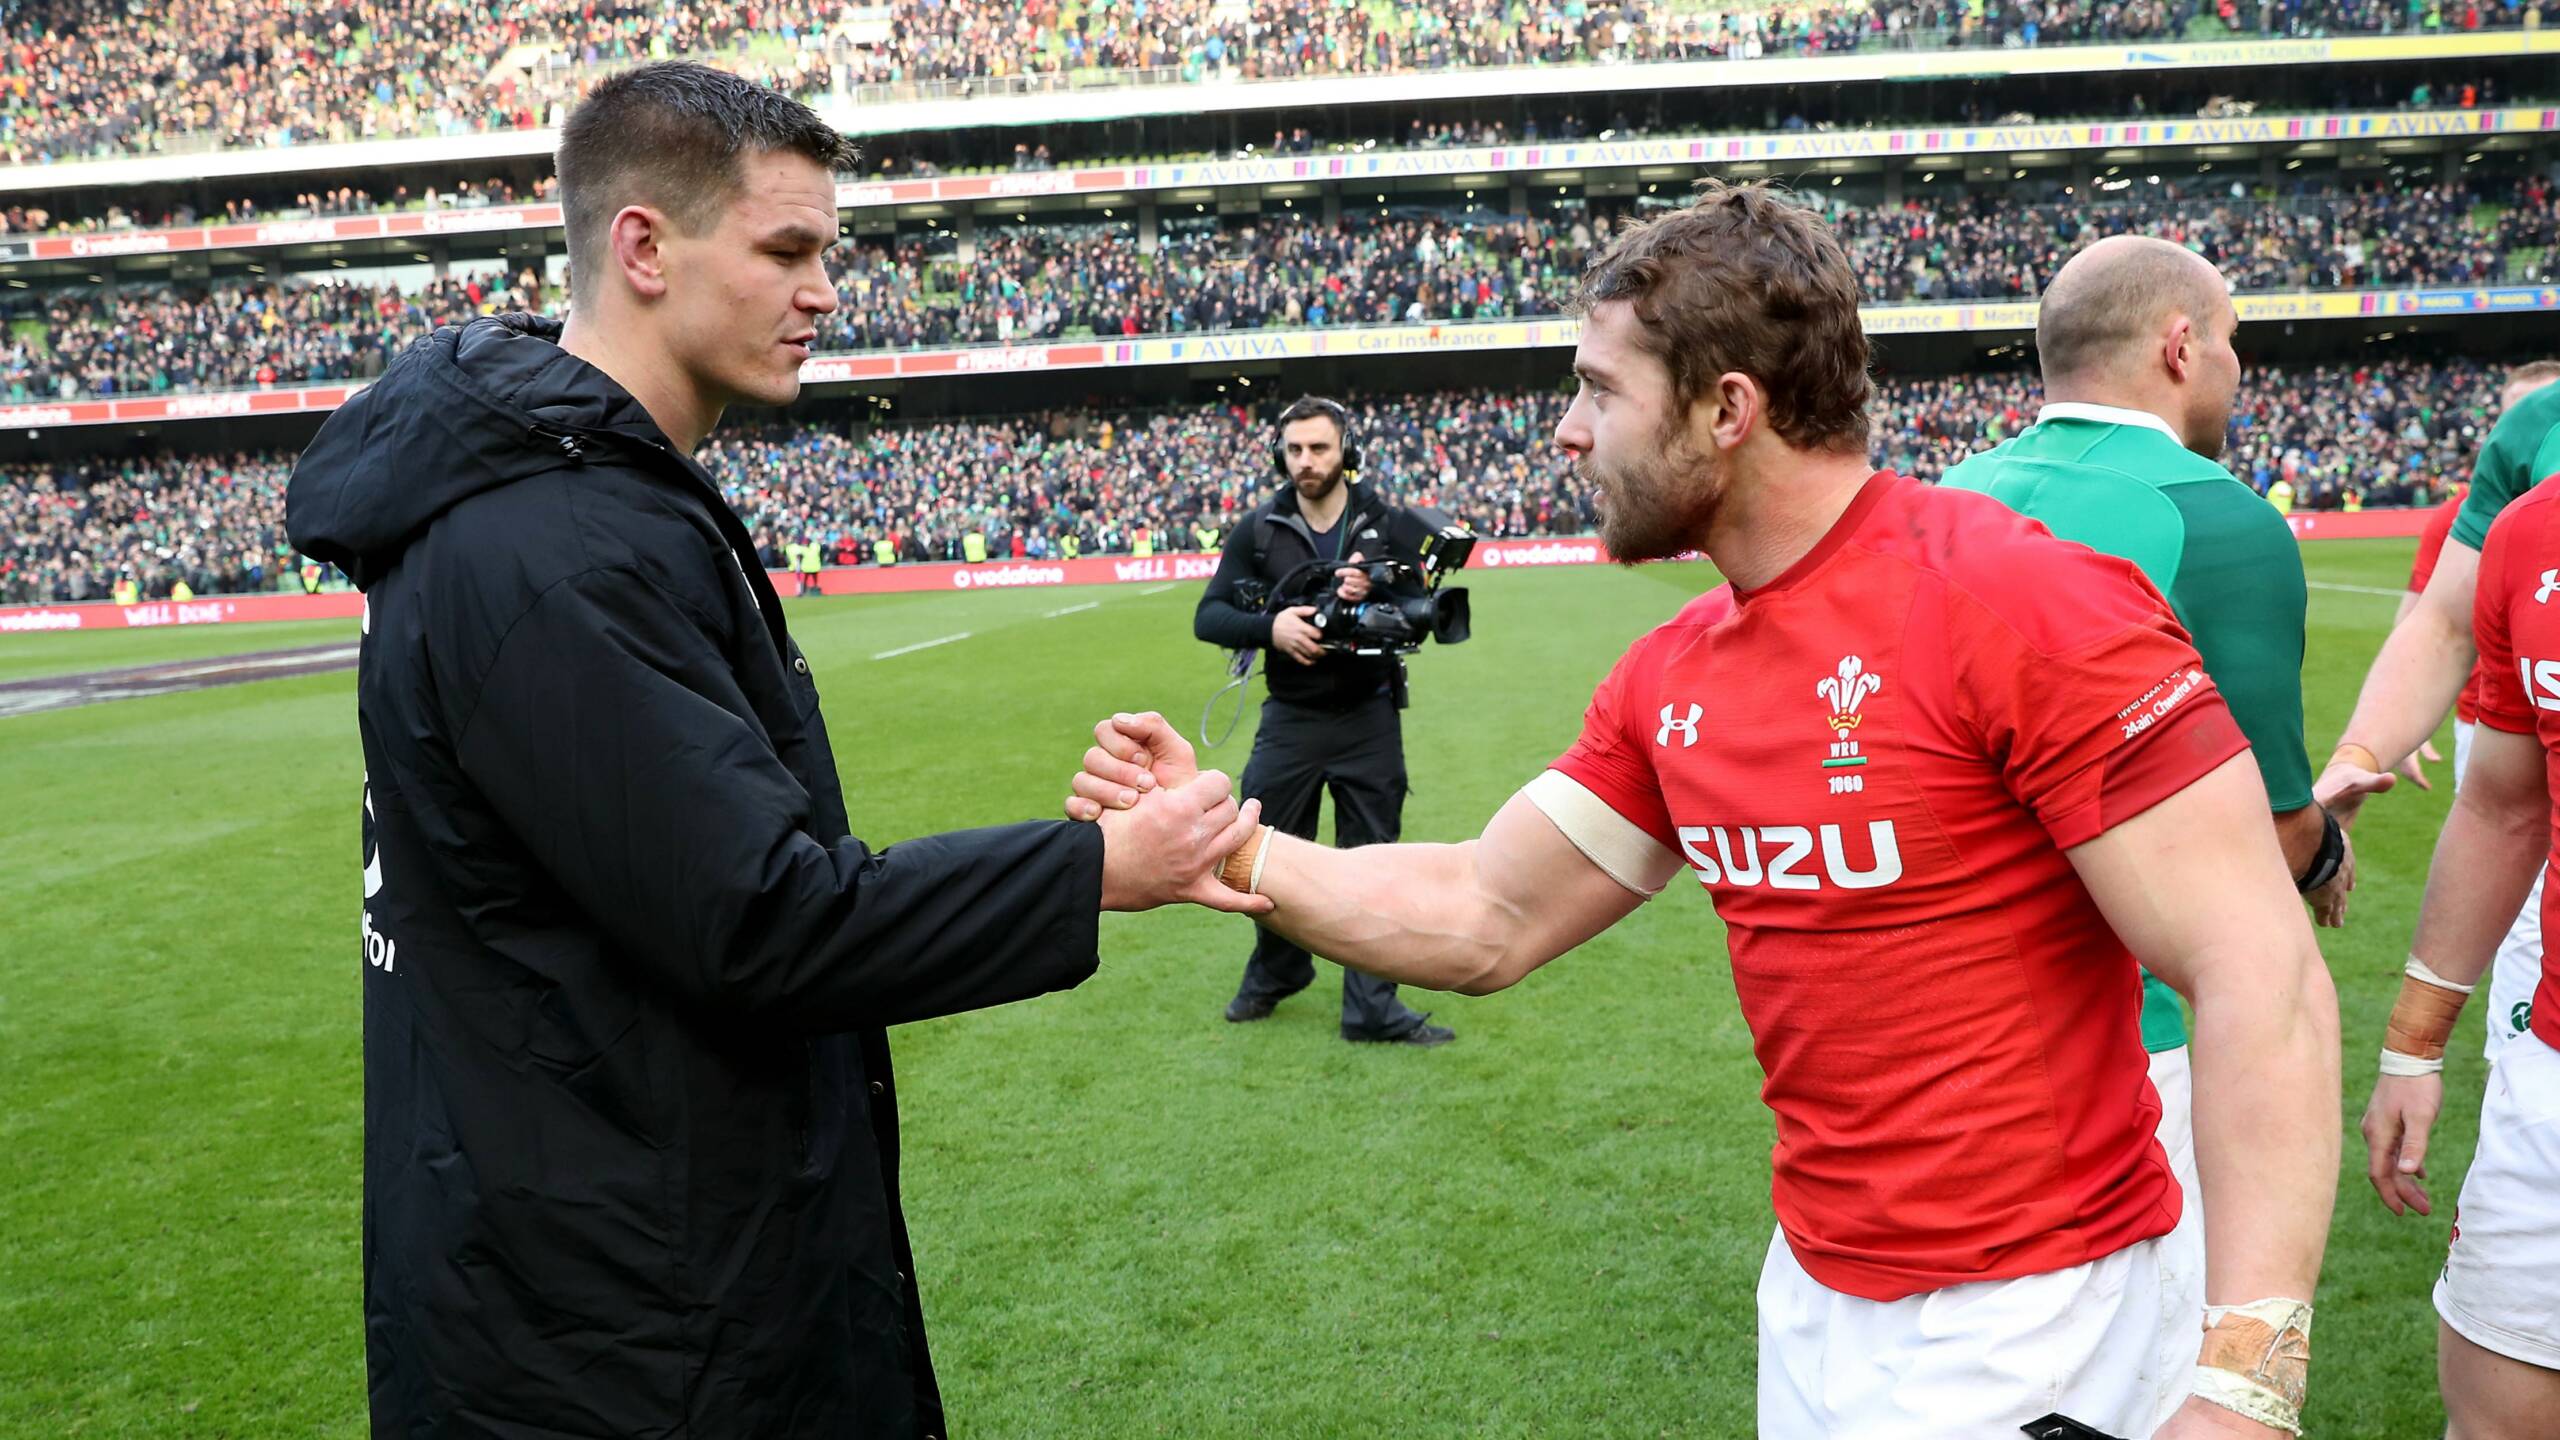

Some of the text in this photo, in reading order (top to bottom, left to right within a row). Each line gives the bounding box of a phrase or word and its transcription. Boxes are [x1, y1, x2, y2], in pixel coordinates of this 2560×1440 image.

[2190, 121, 2272, 141] AVIVA
[2386, 114, 2468, 136] AVIVA
[1794, 134, 1873, 154] AVIVA
[1992, 128, 2072, 147] AVIVA
[1396, 153, 1476, 173] AVIVA
[1593, 143, 1673, 162] AVIVA
[1199, 163, 1277, 183] AVIVA
[1201, 337, 1287, 358] AVIVA
[1358, 329, 1497, 350] Car Insurance
[1502, 543, 1597, 564] vodafone
[972, 563, 1064, 586] vodafone
[1114, 558, 1168, 580] WELL
[0, 609, 81, 630] vodafone
[124, 602, 223, 627] WELL DONE
[1830, 741, 1859, 757] WRU
